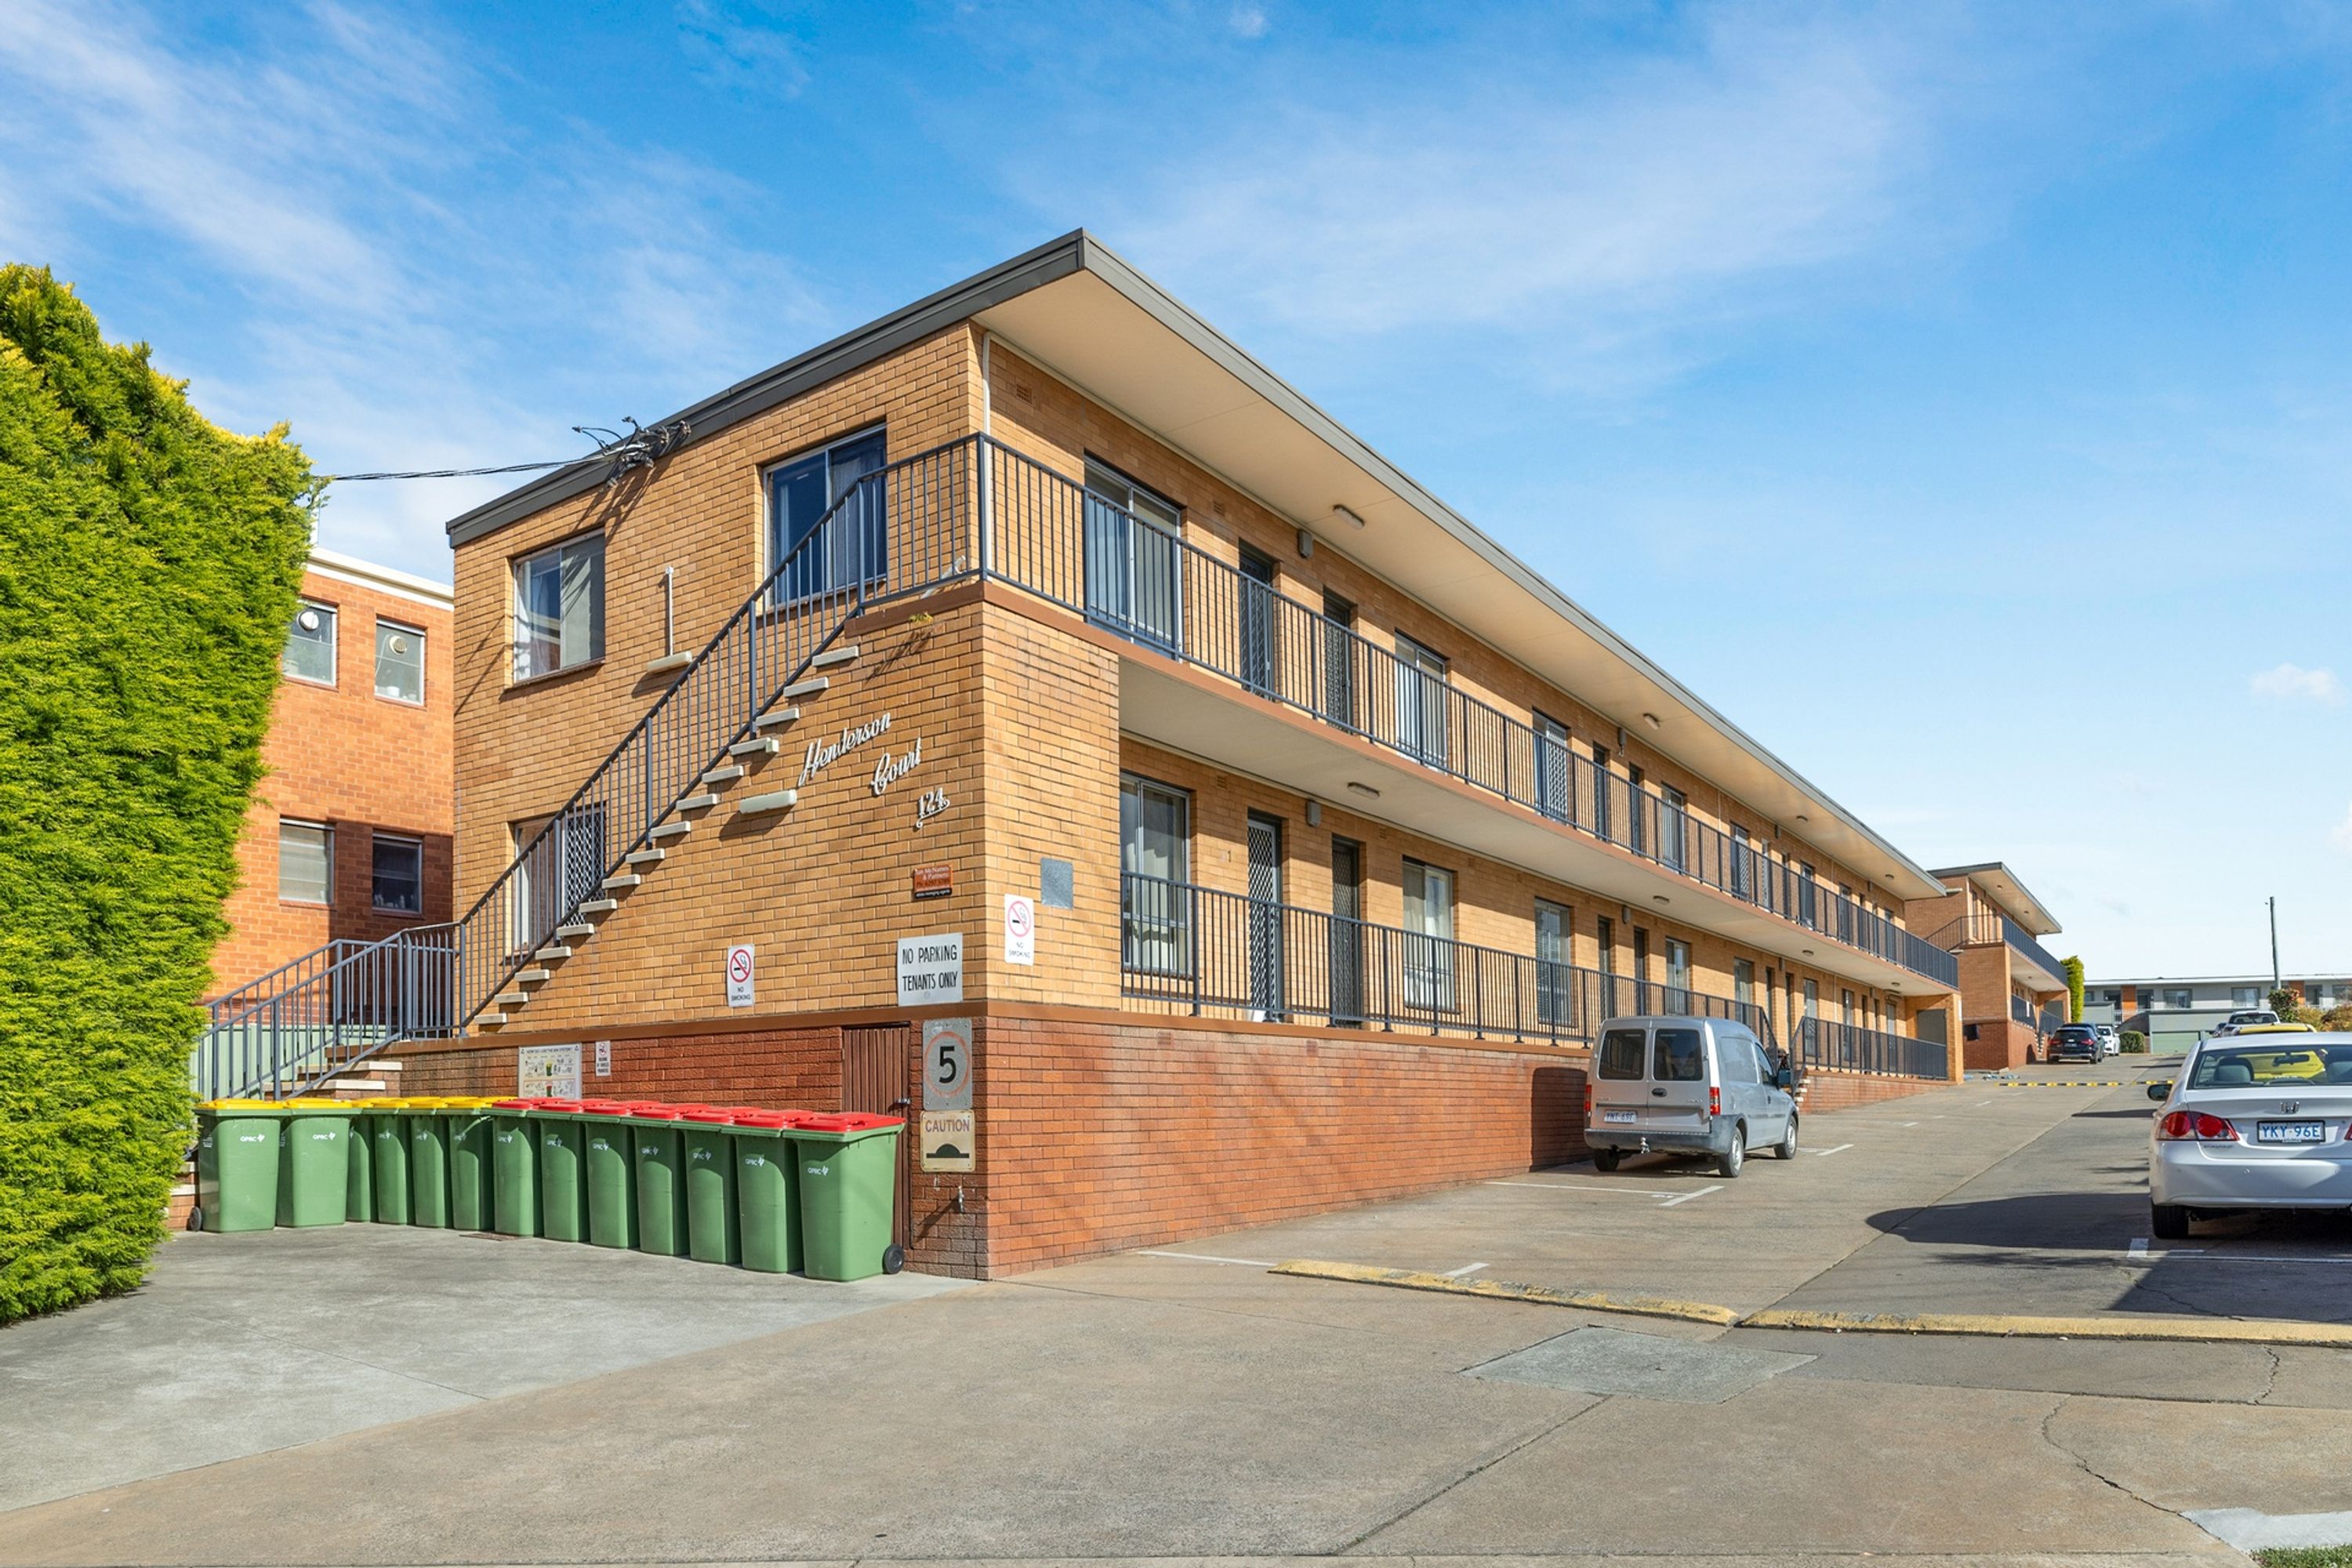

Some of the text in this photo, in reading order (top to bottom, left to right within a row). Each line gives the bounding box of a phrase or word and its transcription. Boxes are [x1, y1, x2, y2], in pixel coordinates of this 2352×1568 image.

[797, 712, 891, 787] Henderson
[870, 736, 923, 796] Court
[917, 787, 947, 820] 124
[902, 944, 958, 964] NO PARKING
[1009, 949, 1031, 959] SMOKING
[902, 971, 959, 992] TENANTS ONLY
[731, 993, 751, 1002] SMOKING
[938, 1045, 956, 1084] 5
[925, 1119, 971, 1133] CAUTION
